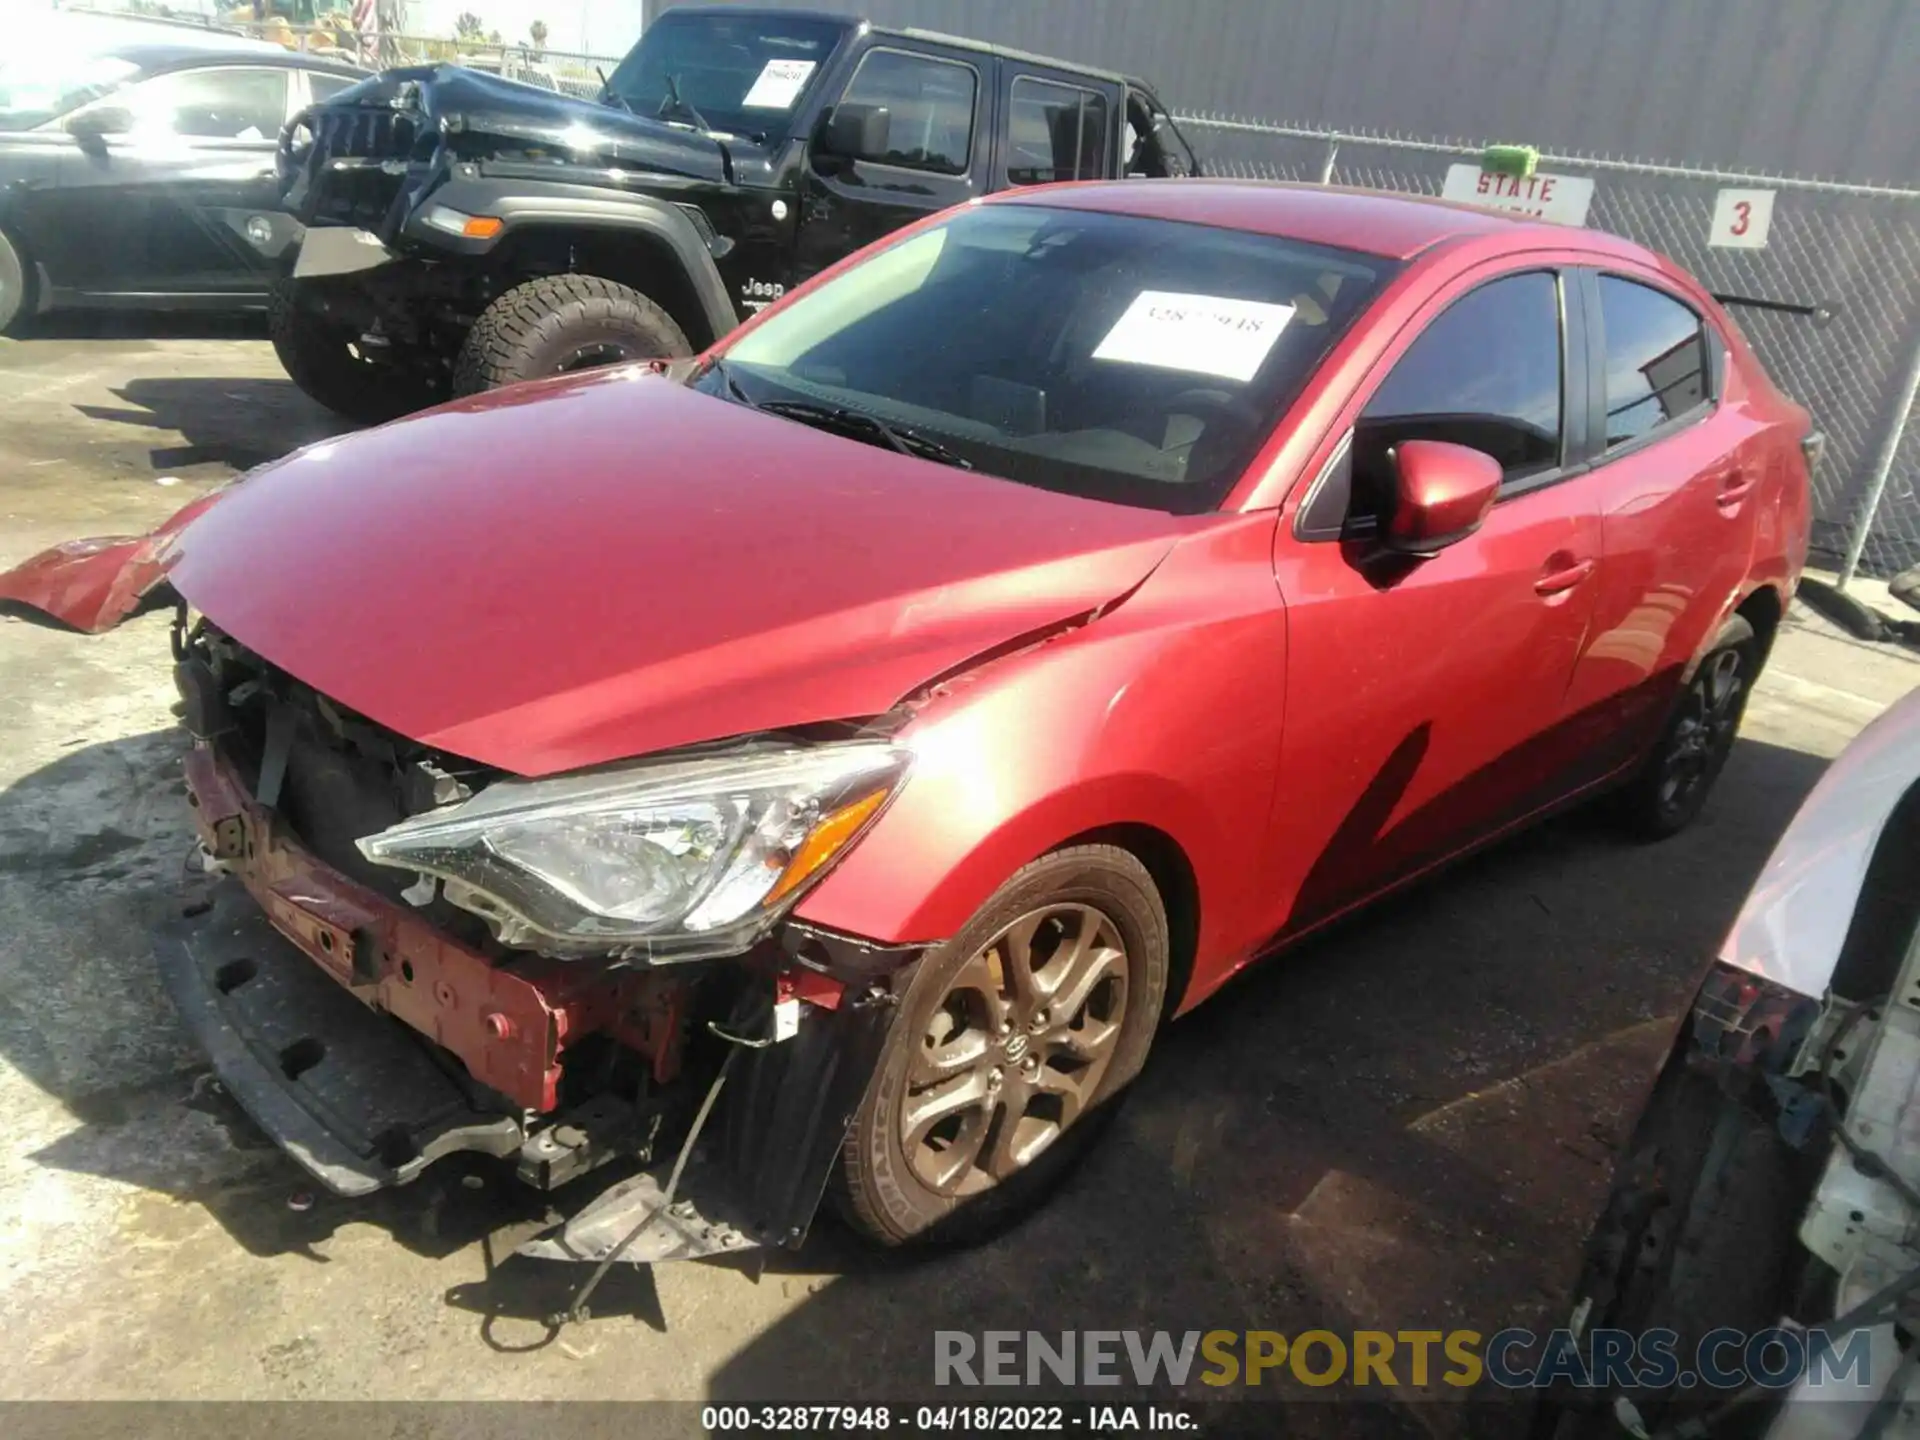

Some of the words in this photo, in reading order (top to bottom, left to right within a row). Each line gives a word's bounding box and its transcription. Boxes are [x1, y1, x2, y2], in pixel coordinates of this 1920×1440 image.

[1476, 171, 1558, 203] STATE
[1730, 200, 1752, 236] 3
[741, 277, 785, 300] Jeep
